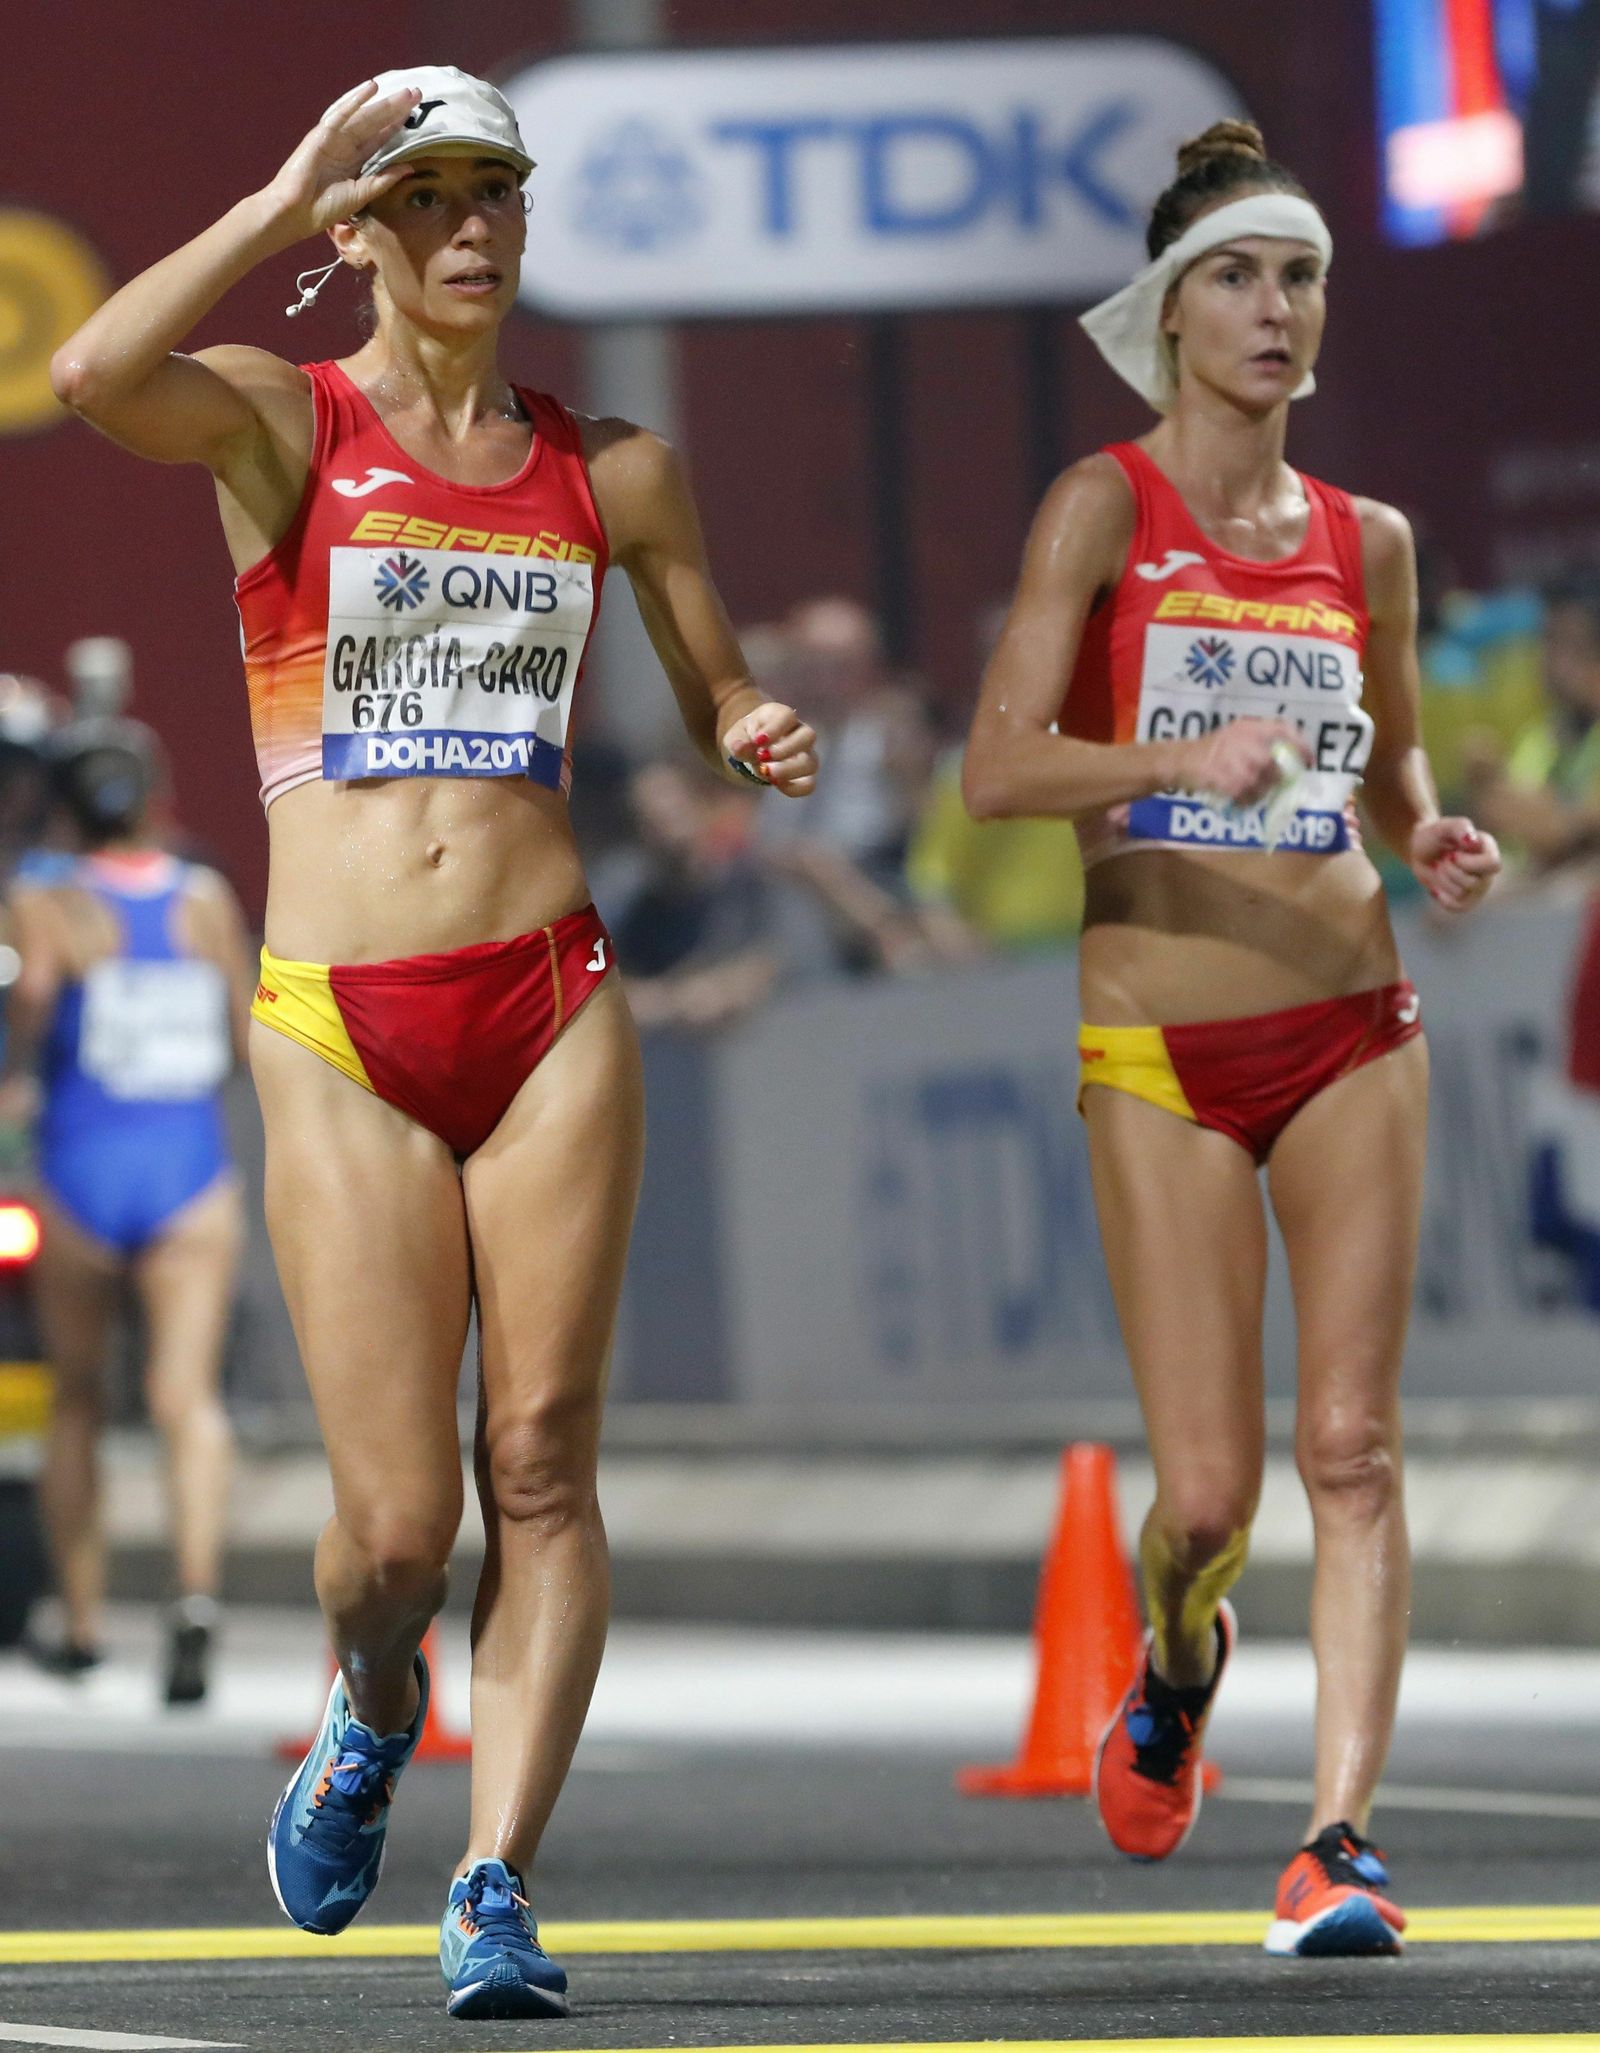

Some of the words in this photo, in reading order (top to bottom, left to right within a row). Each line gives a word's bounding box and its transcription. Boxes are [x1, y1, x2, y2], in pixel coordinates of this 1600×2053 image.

[709, 99, 1142, 234] TDK
[441, 565, 558, 613] QNB
[332, 624, 567, 702] GARCÍA-CARO
[1246, 646, 1344, 690] QNB
[352, 691, 423, 733] 676
[1169, 804, 1337, 848] DOHA019
